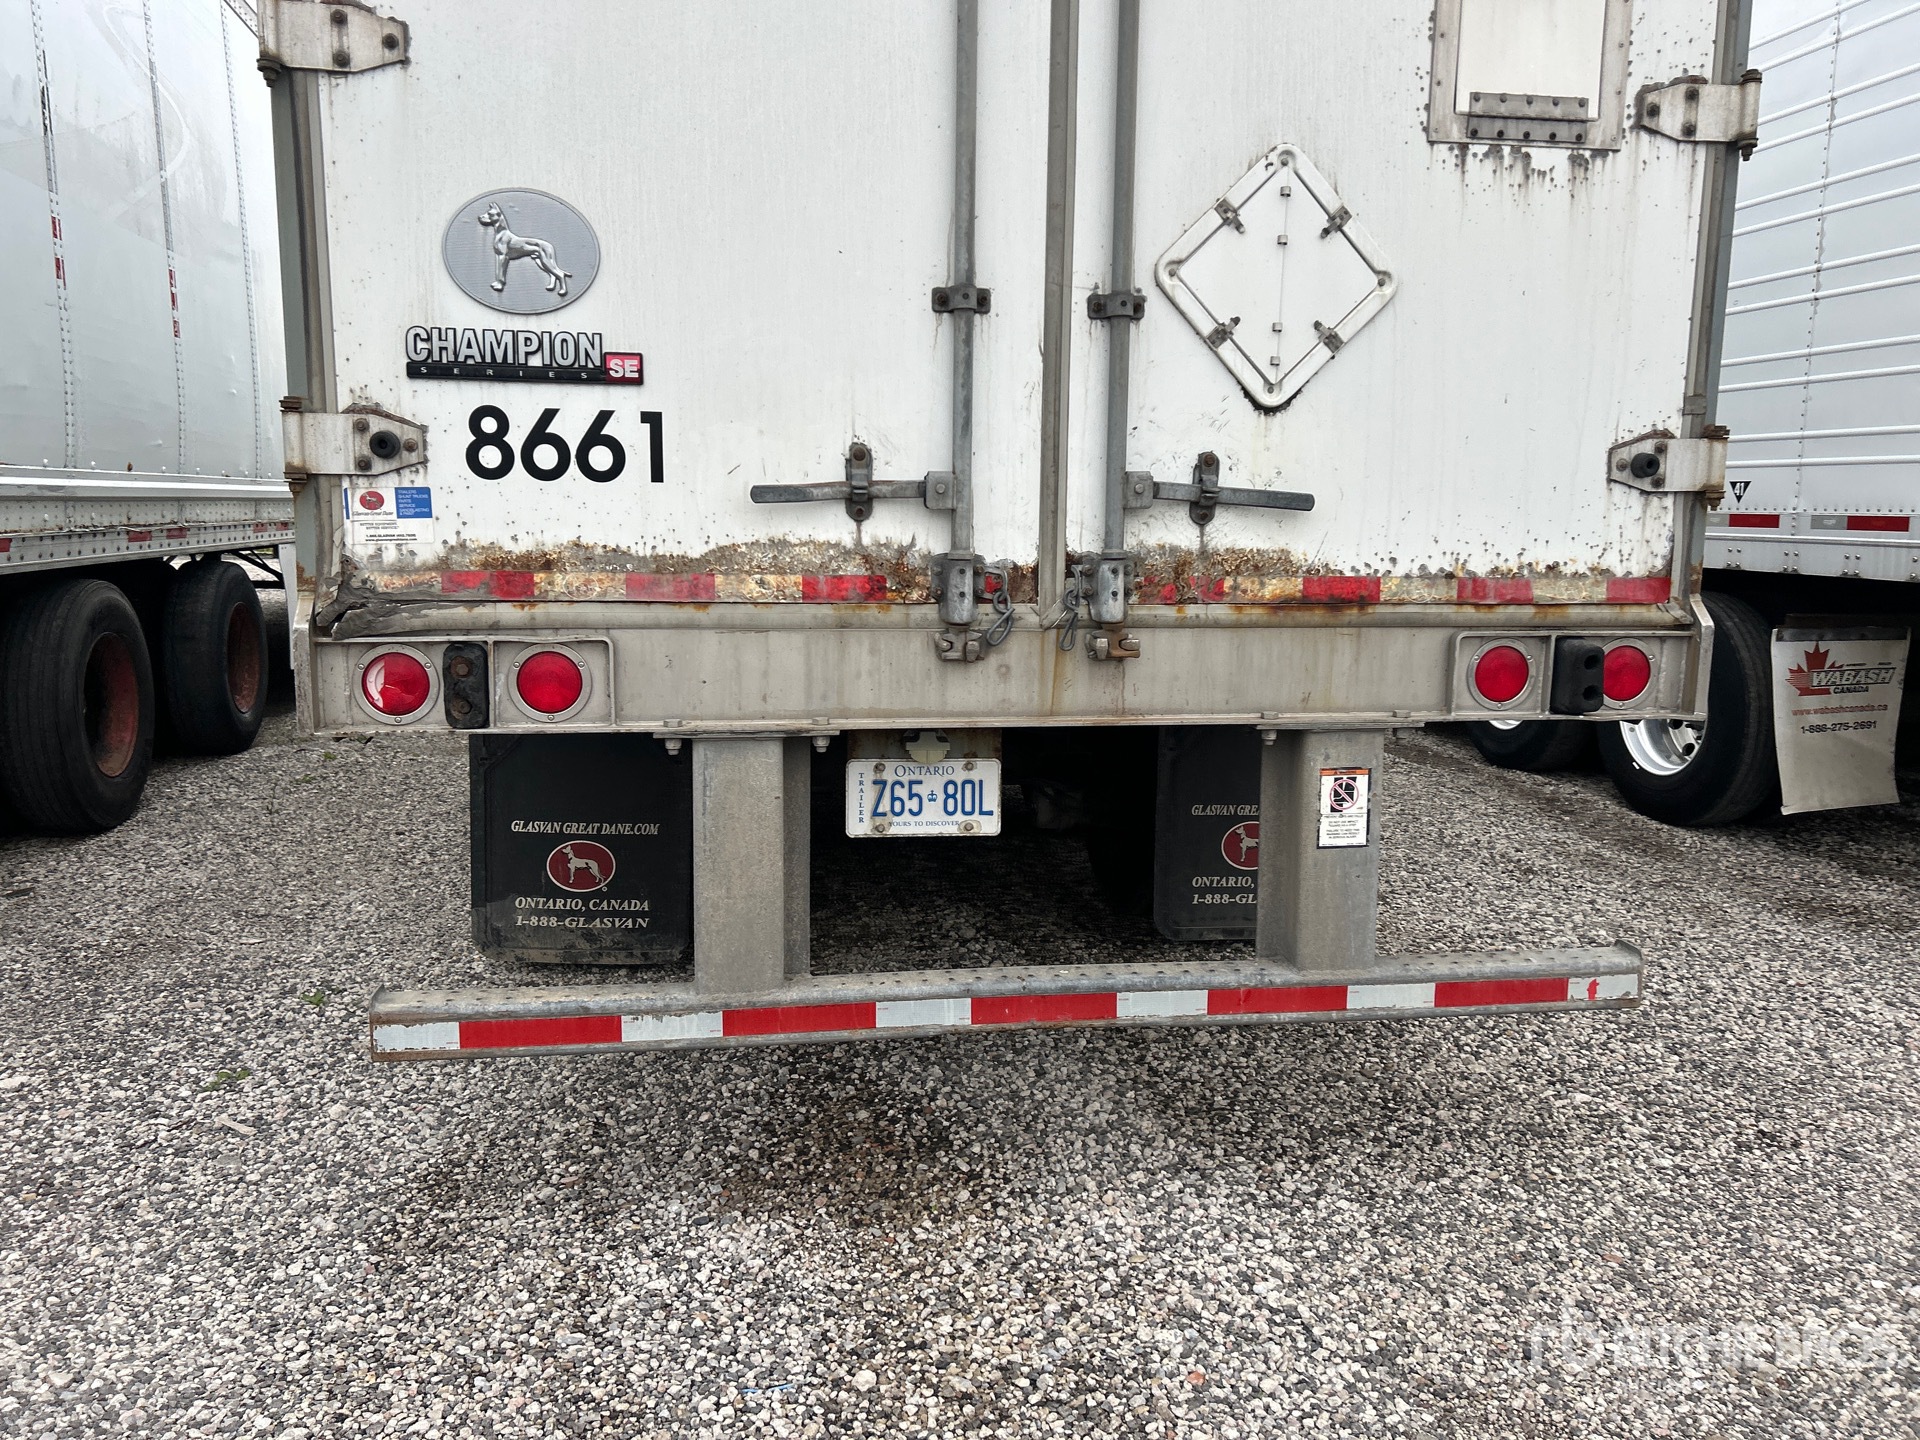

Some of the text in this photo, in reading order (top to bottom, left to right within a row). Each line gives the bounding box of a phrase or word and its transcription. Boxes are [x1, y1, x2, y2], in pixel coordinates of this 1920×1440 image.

[406, 326, 602, 368] CHAMPION
[420, 367, 588, 379] SERIES
[609, 358, 639, 378] SE
[465, 404, 664, 483] 8661
[1734, 482, 1745, 496] 41
[1812, 668, 1895, 686] WABASH
[1833, 686, 1869, 694] CANADA
[1791, 703, 1888, 716] www.wabashcanada.ca
[1801, 721, 1877, 734] 1-888-275-2691
[894, 765, 955, 777] ONTARIO
[872, 779, 994, 817] Z65 80L
[1192, 804, 1237, 816] GLASVAN
[511, 820, 660, 835] GLASVAN GREAT DANE.COM
[1191, 876, 1255, 889] ONTARIO,
[514, 897, 649, 912] ONTARIO, CANADA
[1191, 893, 1257, 905] 1-888-GL
[515, 915, 649, 929] 1-888-GLASVAN
